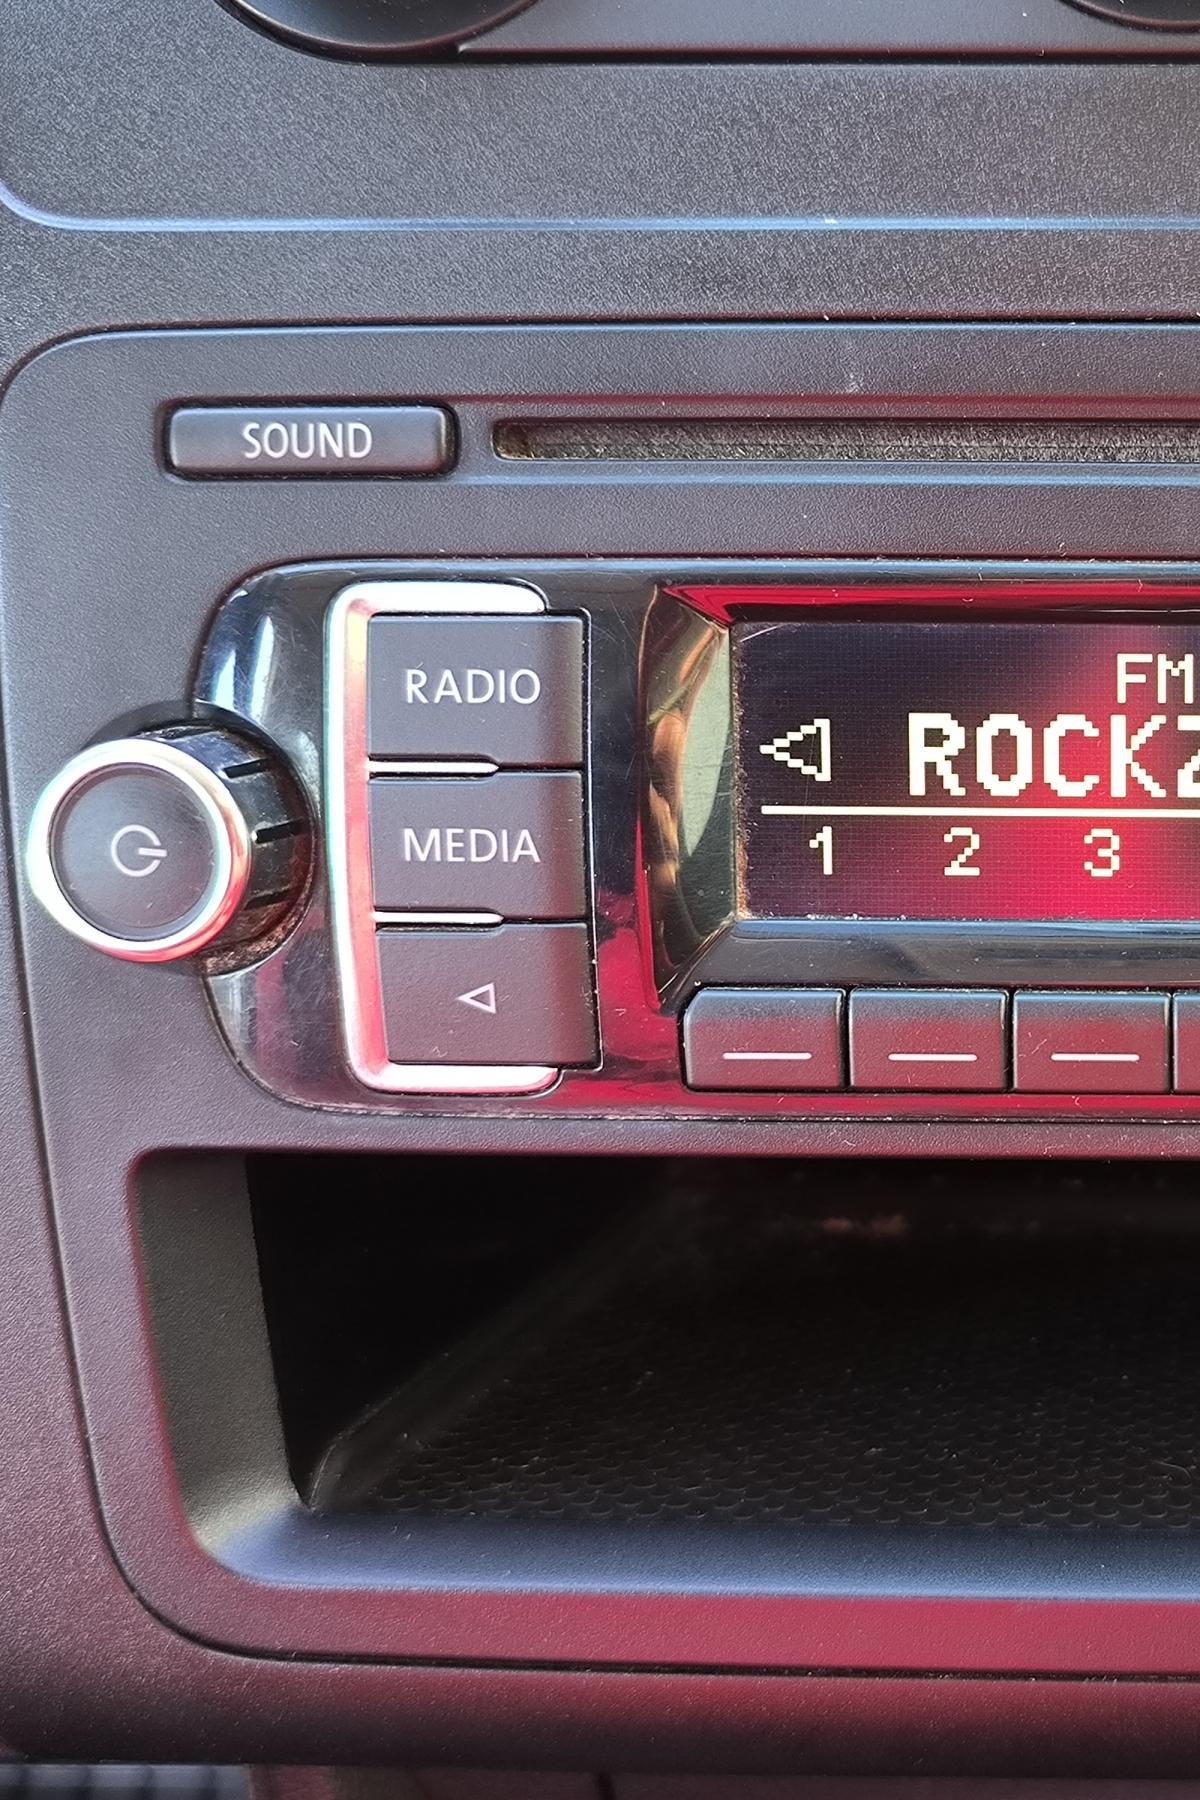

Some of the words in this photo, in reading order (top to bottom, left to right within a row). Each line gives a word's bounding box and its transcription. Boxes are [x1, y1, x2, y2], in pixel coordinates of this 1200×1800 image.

[242, 421, 373, 459] SOUND
[405, 668, 541, 704] RADIO
[402, 827, 541, 863] MEDIA
[809, 825, 833, 876] 1
[943, 826, 981, 877] 2
[1083, 827, 1121, 878] 3
